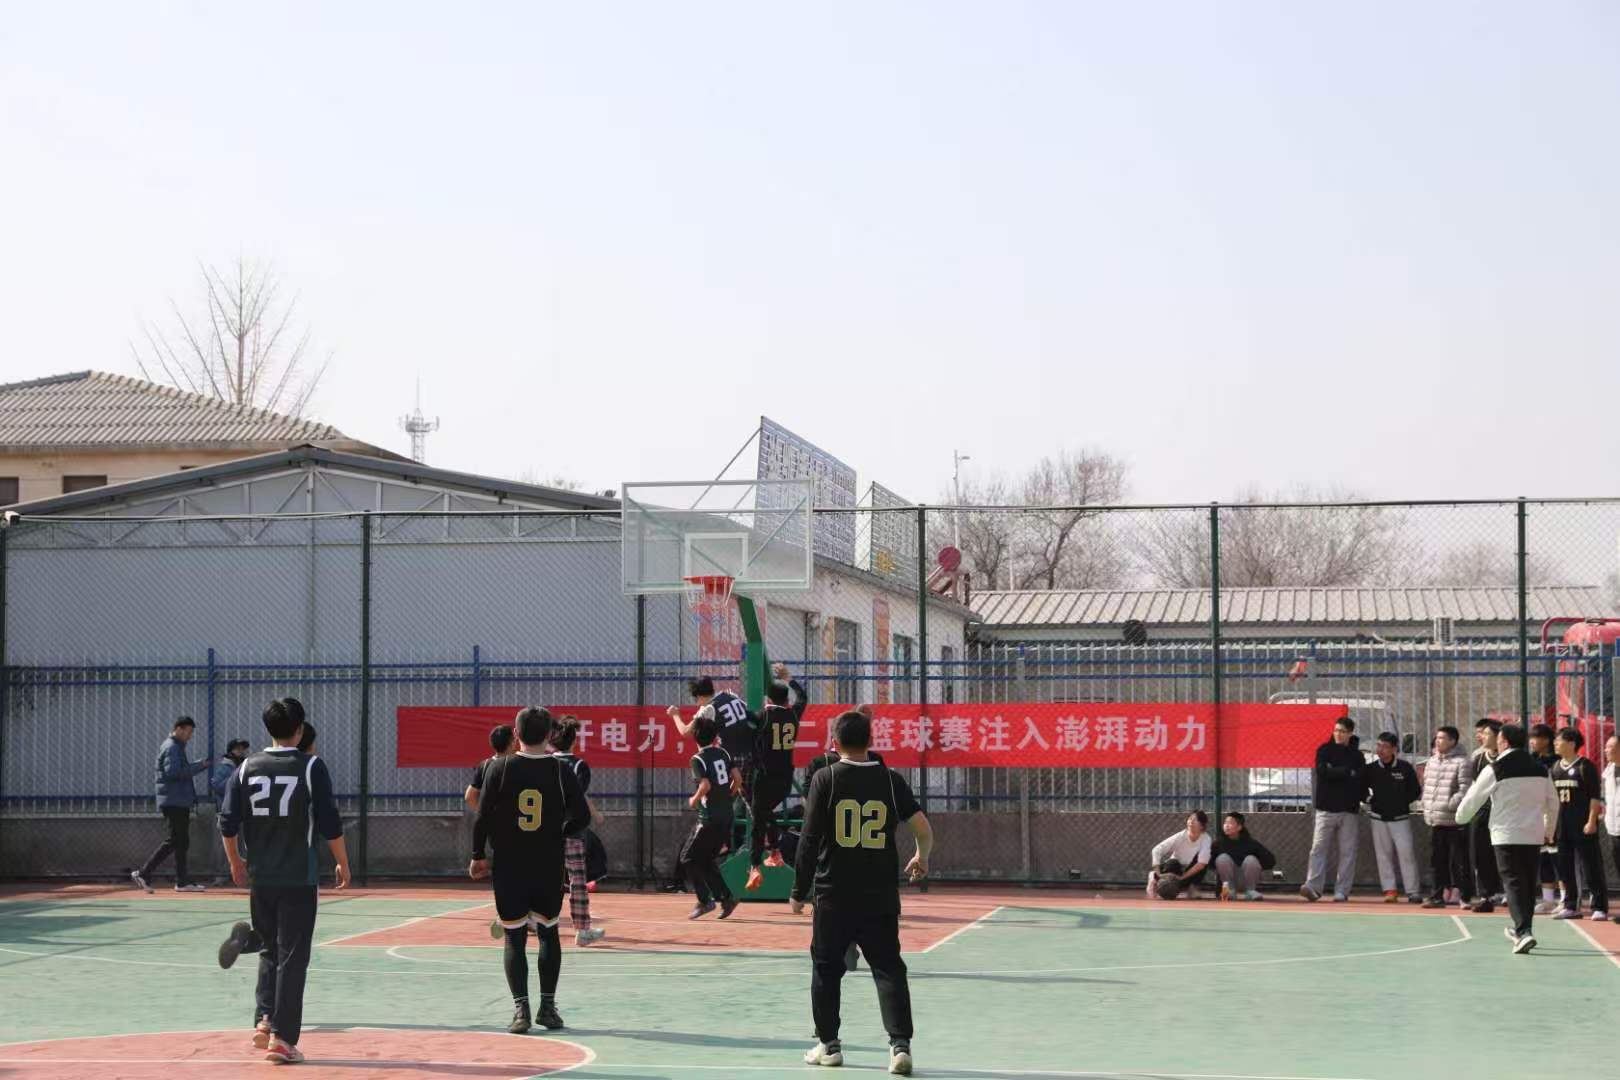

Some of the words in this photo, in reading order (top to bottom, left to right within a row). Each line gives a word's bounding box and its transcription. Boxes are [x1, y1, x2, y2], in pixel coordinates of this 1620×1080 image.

[718, 699, 748, 727] 30
[771, 722, 796, 751] 12
[713, 759, 729, 786] 8
[248, 775, 298, 817] 27
[518, 788, 543, 832] 9
[835, 799, 887, 849] 02
